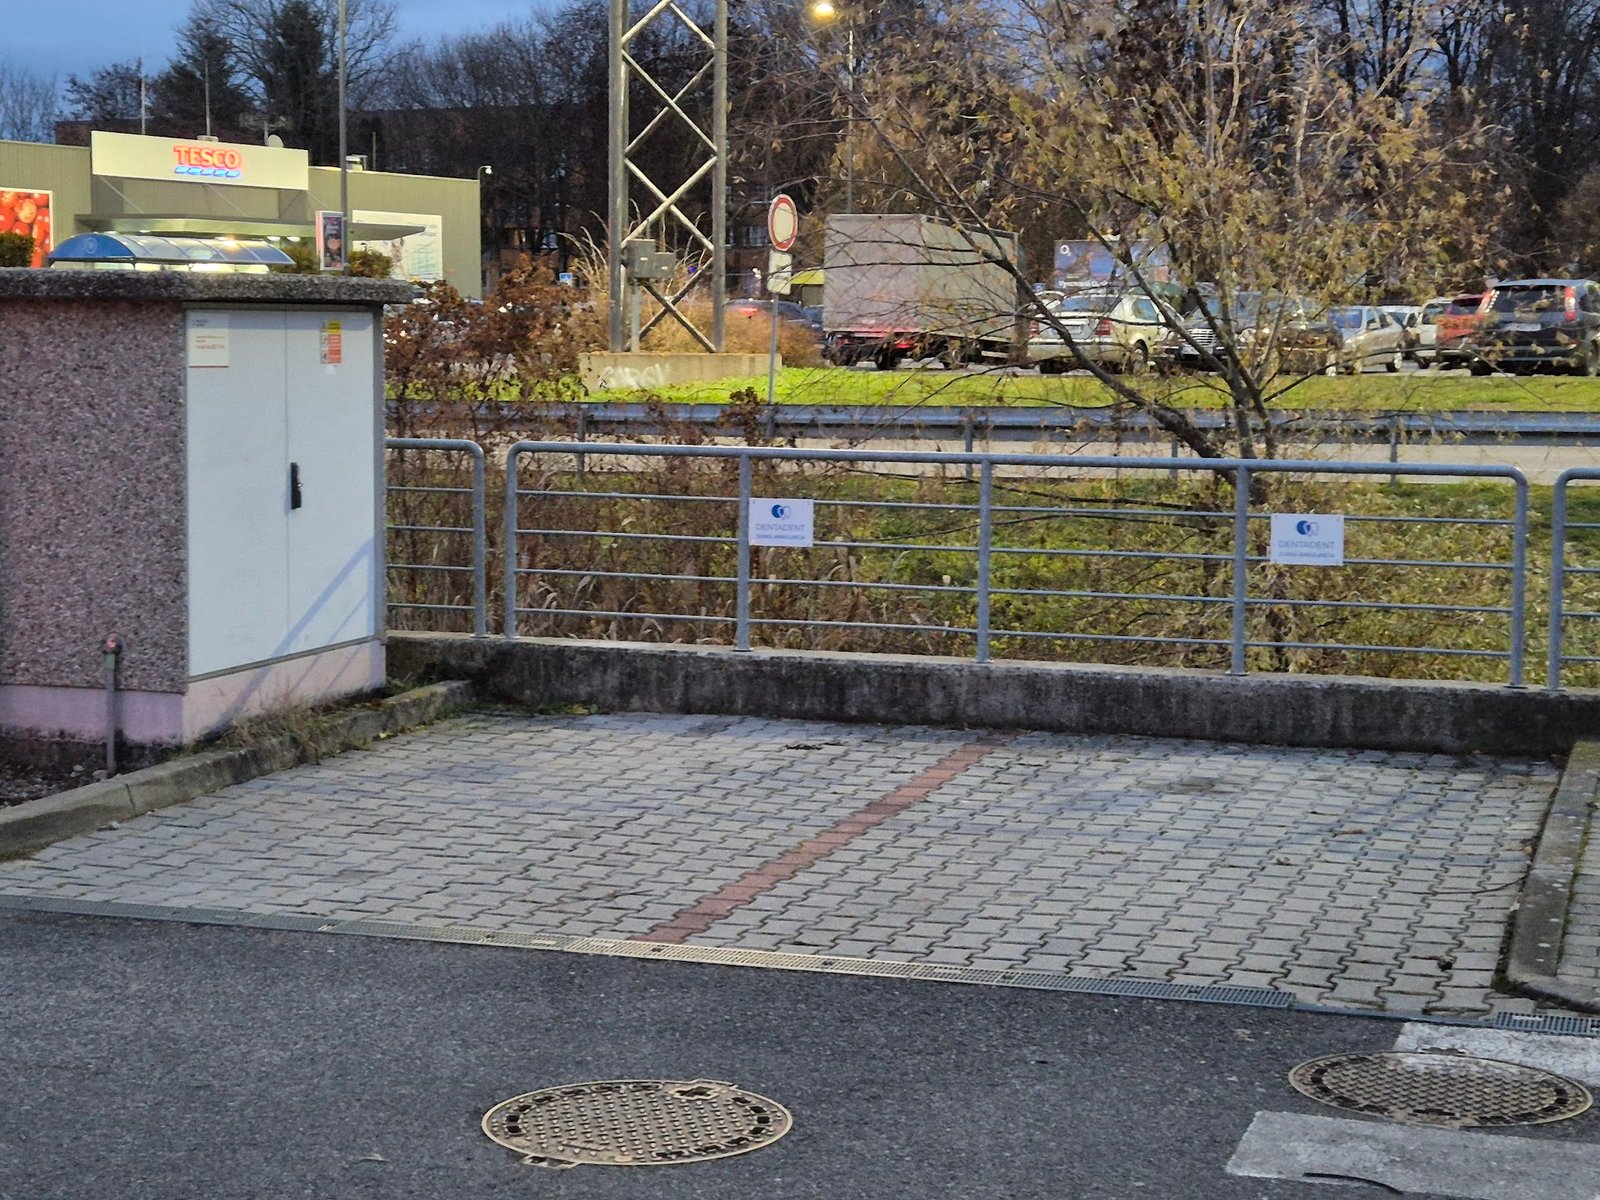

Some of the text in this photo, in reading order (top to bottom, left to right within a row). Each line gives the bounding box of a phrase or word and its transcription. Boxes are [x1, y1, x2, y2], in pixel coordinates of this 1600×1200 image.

[173, 145, 241, 170] TESCO
[755, 523, 806, 531] DENTADENT
[1278, 539, 1335, 549] DENTADENT
